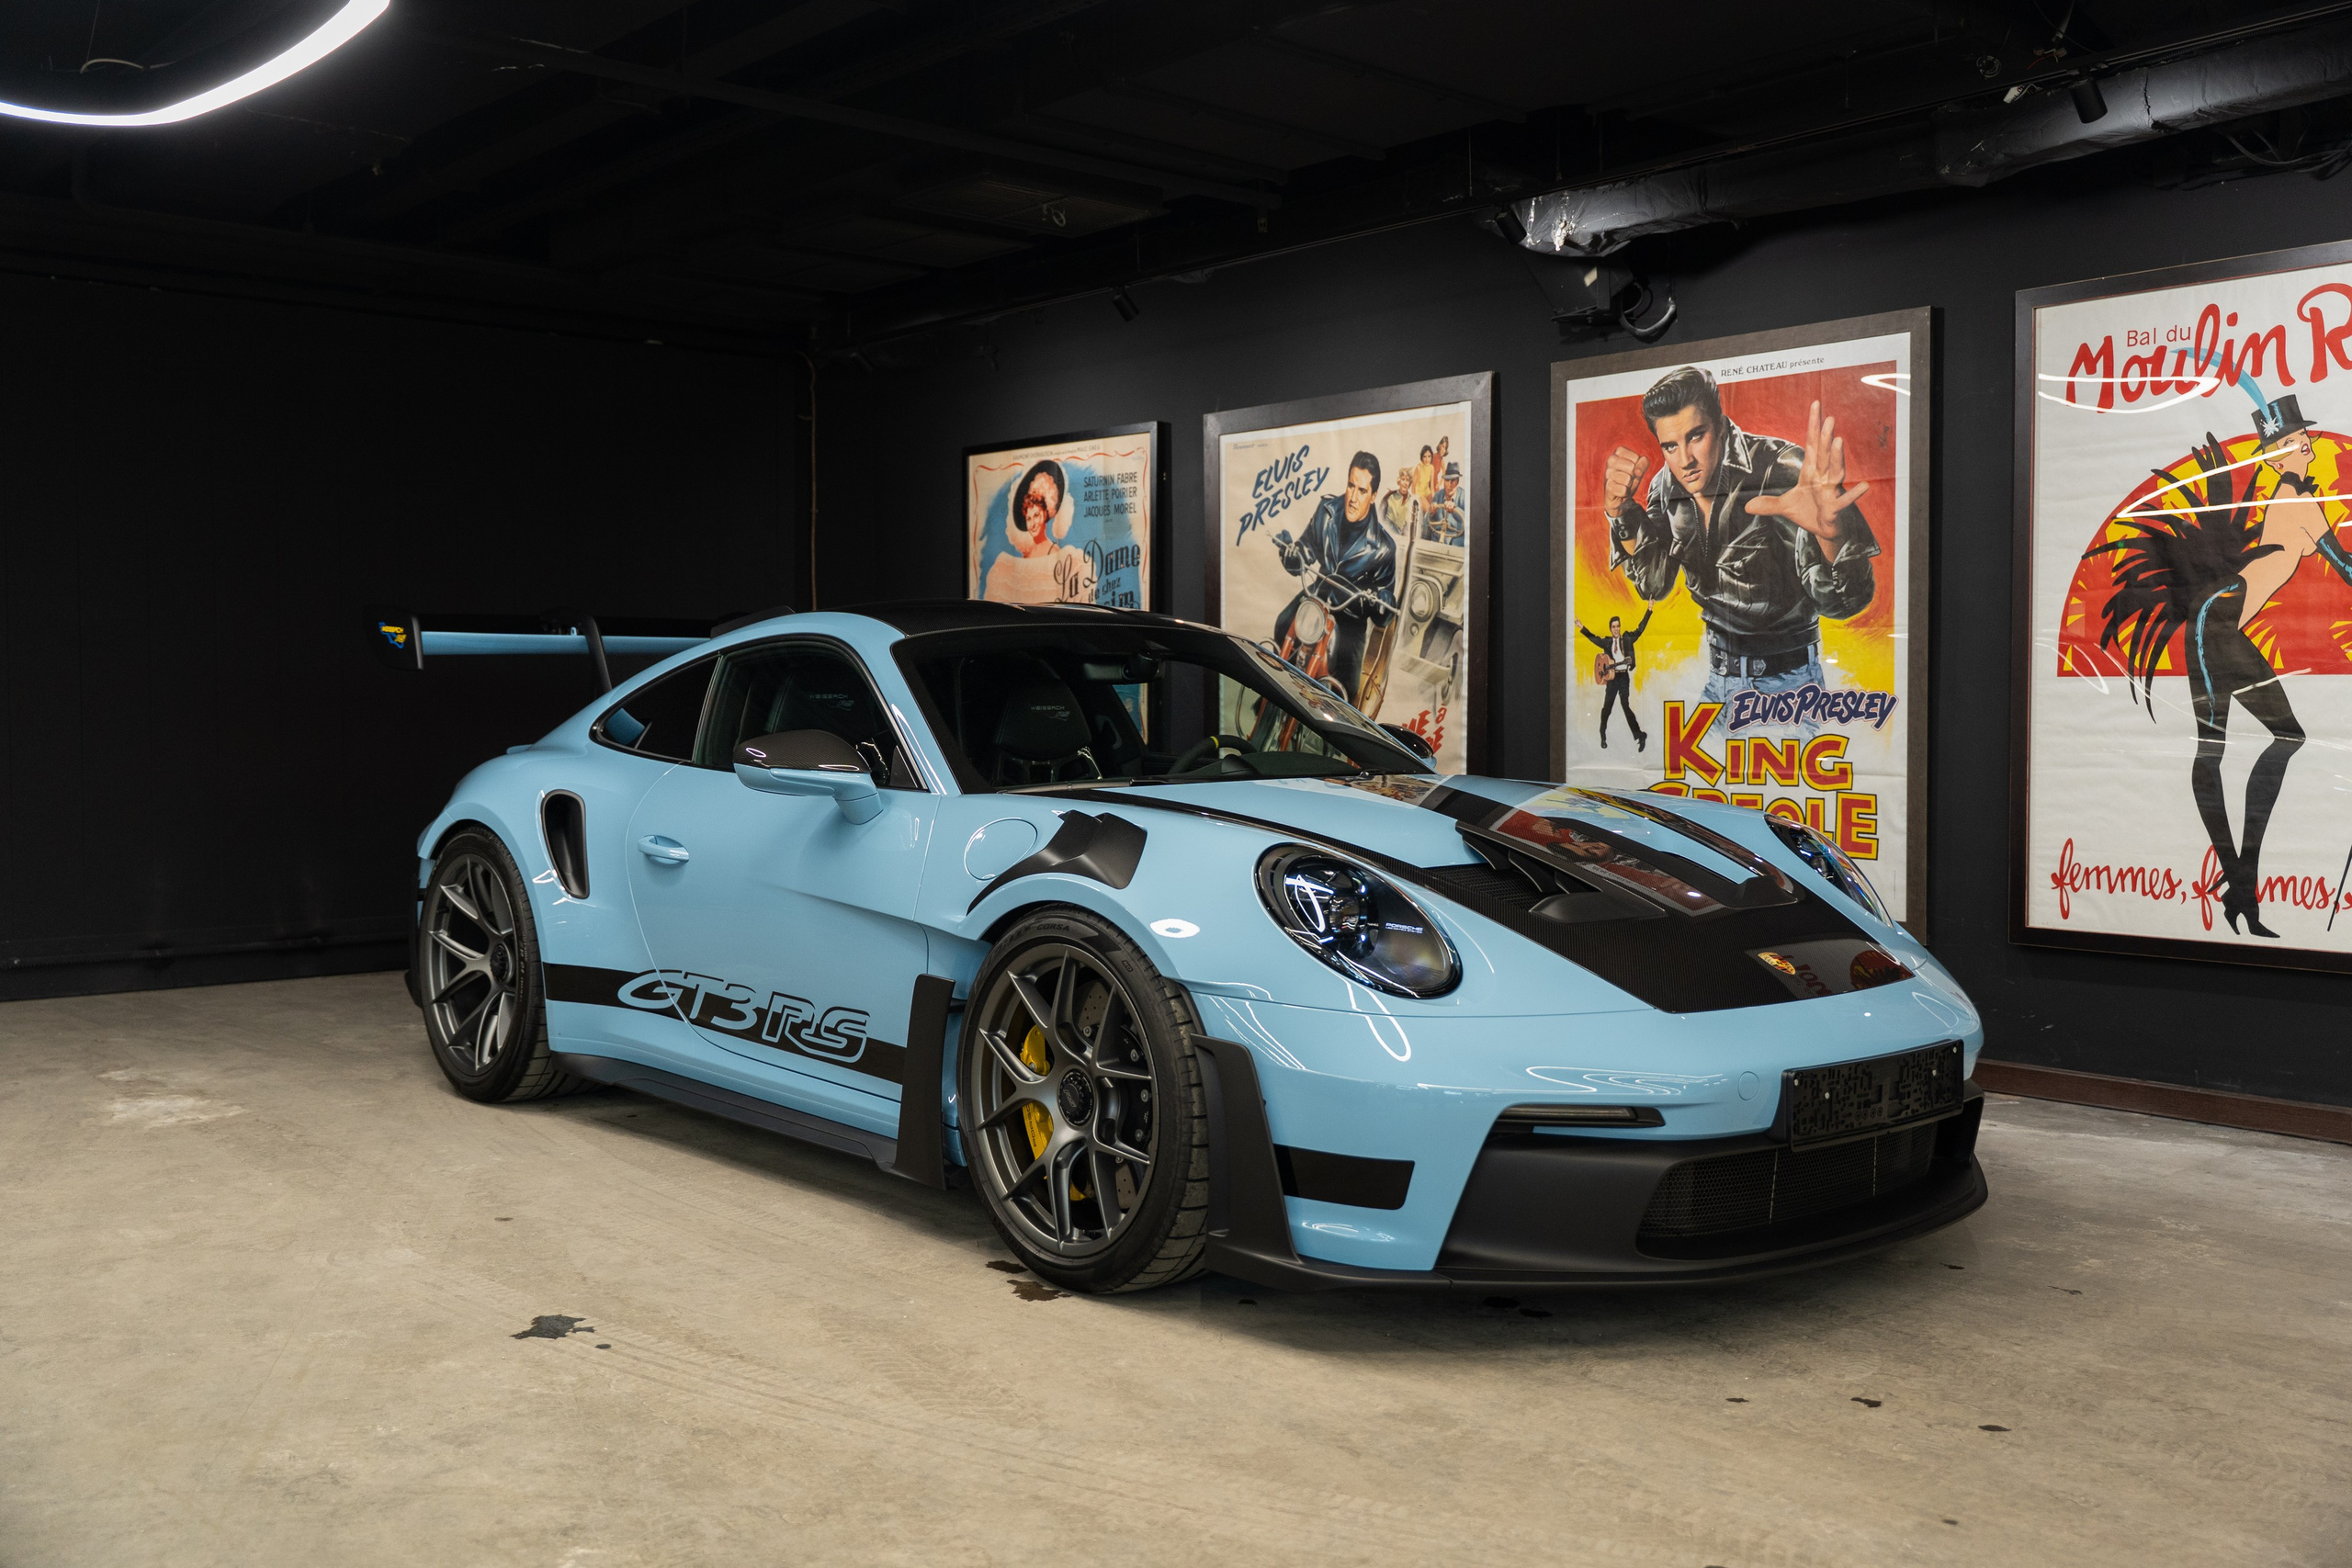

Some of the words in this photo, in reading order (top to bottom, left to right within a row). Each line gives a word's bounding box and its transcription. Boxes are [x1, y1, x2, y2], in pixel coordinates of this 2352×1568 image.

[2126, 327, 2157, 347] Bal
[2165, 324, 2192, 343] du
[1721, 366, 1744, 377] RENÉ
[1747, 361, 1788, 374] CHATEAU
[1790, 357, 1825, 368] présente
[2065, 303, 2296, 413] Moulin
[1083, 473, 1115, 488] SATURNIN
[1117, 471, 1137, 484] FABRE
[1252, 445, 1310, 499] ELVIS
[1083, 488, 1109, 502] ARLETTE
[1112, 486, 1137, 500] POIRIER
[1083, 504, 1111, 517] JACQUES
[1114, 502, 1137, 514] MOREL
[1236, 467, 1330, 547] PRESLEY
[1082, 538, 1141, 589] Dame
[1102, 577, 1121, 595] chez
[1664, 700, 1853, 791] KING
[2050, 837, 2187, 920] femmes,
[1036, 922, 1070, 931] CORSA
[1026, 1104, 1036, 1147] PORSC
